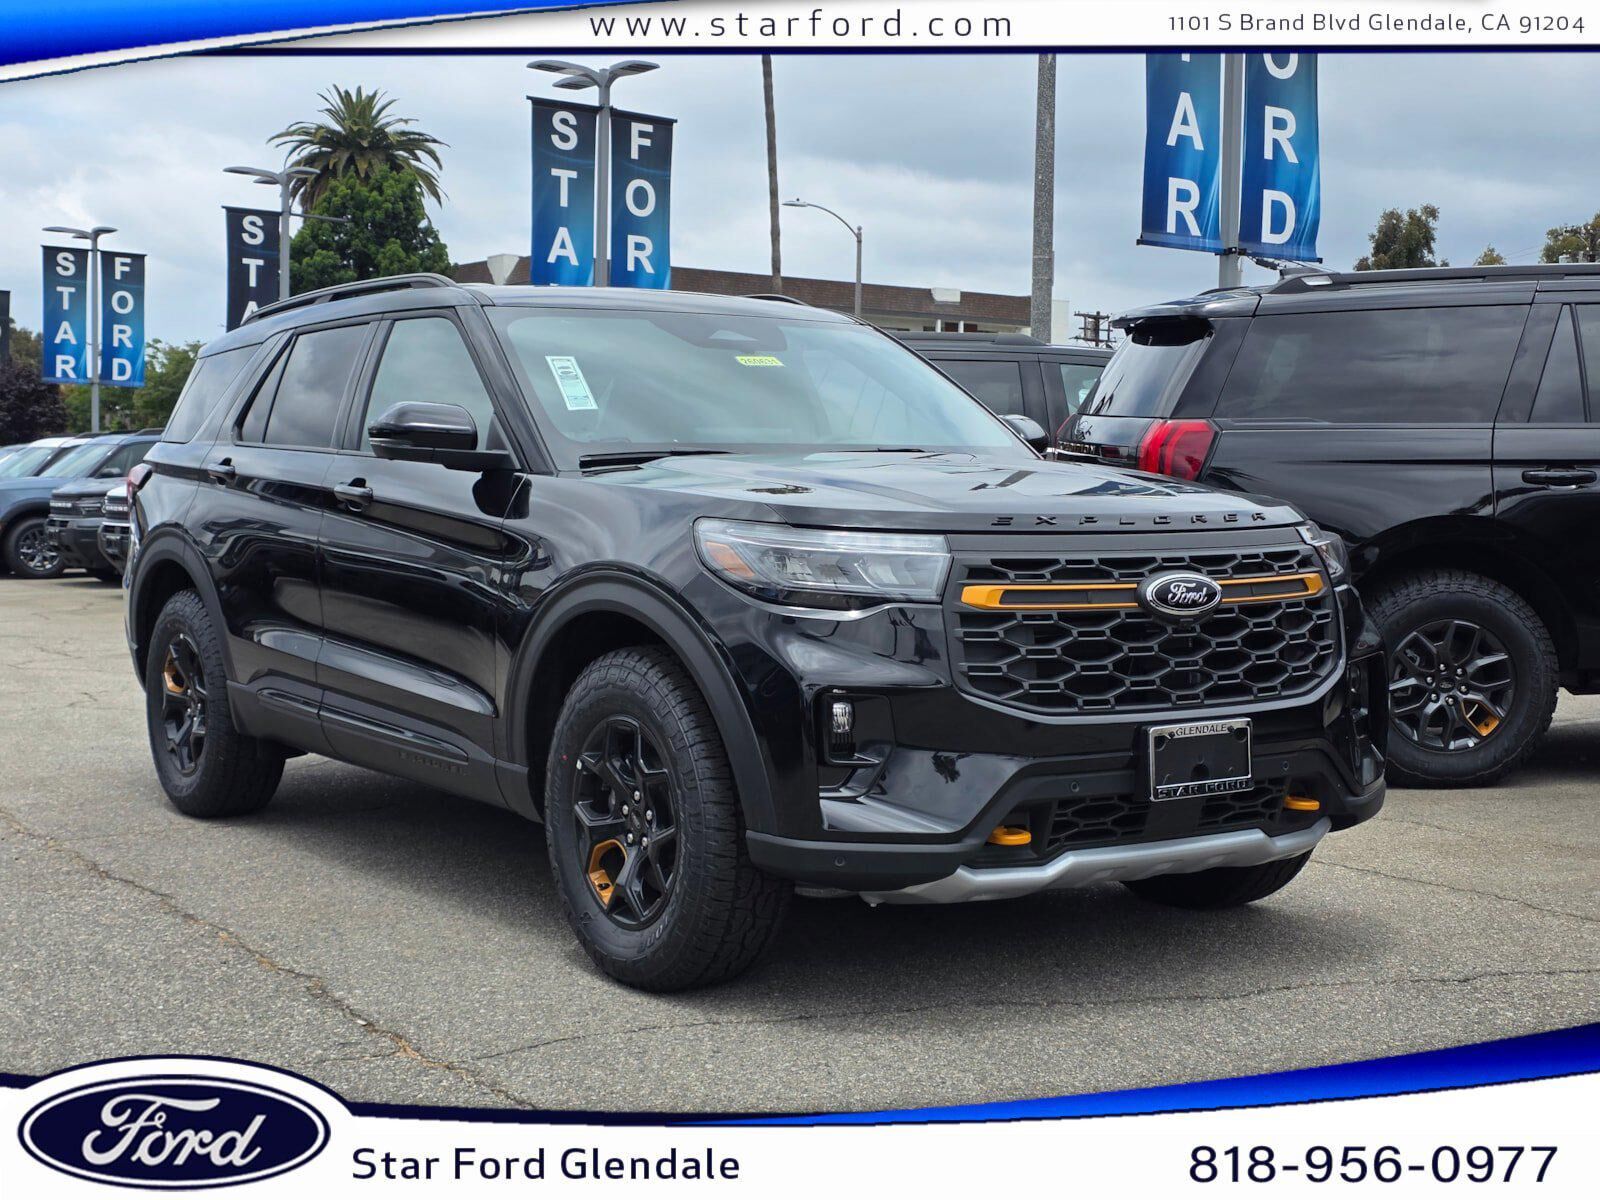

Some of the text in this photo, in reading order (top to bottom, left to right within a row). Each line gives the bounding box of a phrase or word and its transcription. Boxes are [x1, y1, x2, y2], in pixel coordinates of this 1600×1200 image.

[1166, 54, 1205, 237] AR
[547, 110, 579, 286] STA
[54, 251, 78, 379] STAR
[111, 256, 135, 381] FORD
[990, 512, 1267, 527] EXPLORER
[1167, 582, 1208, 605] Ford
[1175, 723, 1229, 738] GLENDALE
[1157, 779, 1247, 799] STAR FORD
